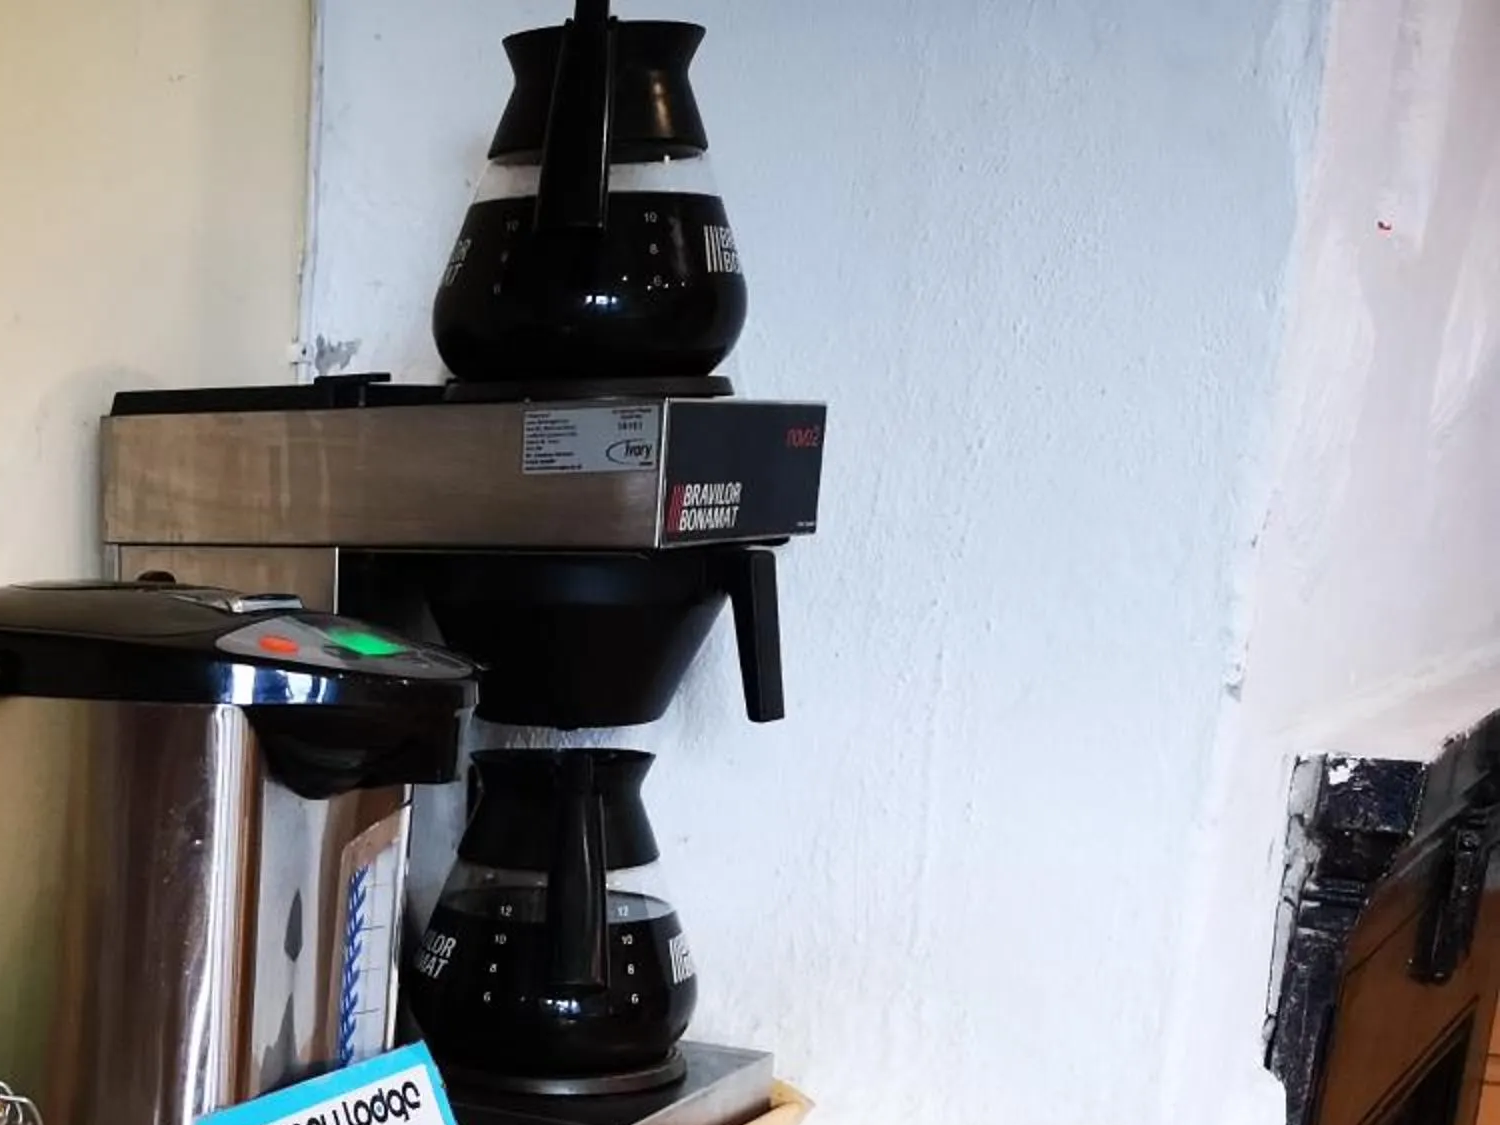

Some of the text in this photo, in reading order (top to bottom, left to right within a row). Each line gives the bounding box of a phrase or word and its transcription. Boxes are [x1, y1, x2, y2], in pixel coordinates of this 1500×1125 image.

[644, 211, 658, 223] 10
[649, 243, 659, 255] 8
[683, 482, 742, 507] BRAVILOR
[679, 506, 739, 531] BONAMAT
[501, 904, 513, 917] 12
[618, 905, 629, 917] 12
[495, 933, 507, 945] 10
[622, 933, 633, 945] 10
[489, 963, 498, 973] 8
[627, 963, 635, 975] 8
[483, 991, 492, 1002] 6
[631, 993, 639, 1004] 6
